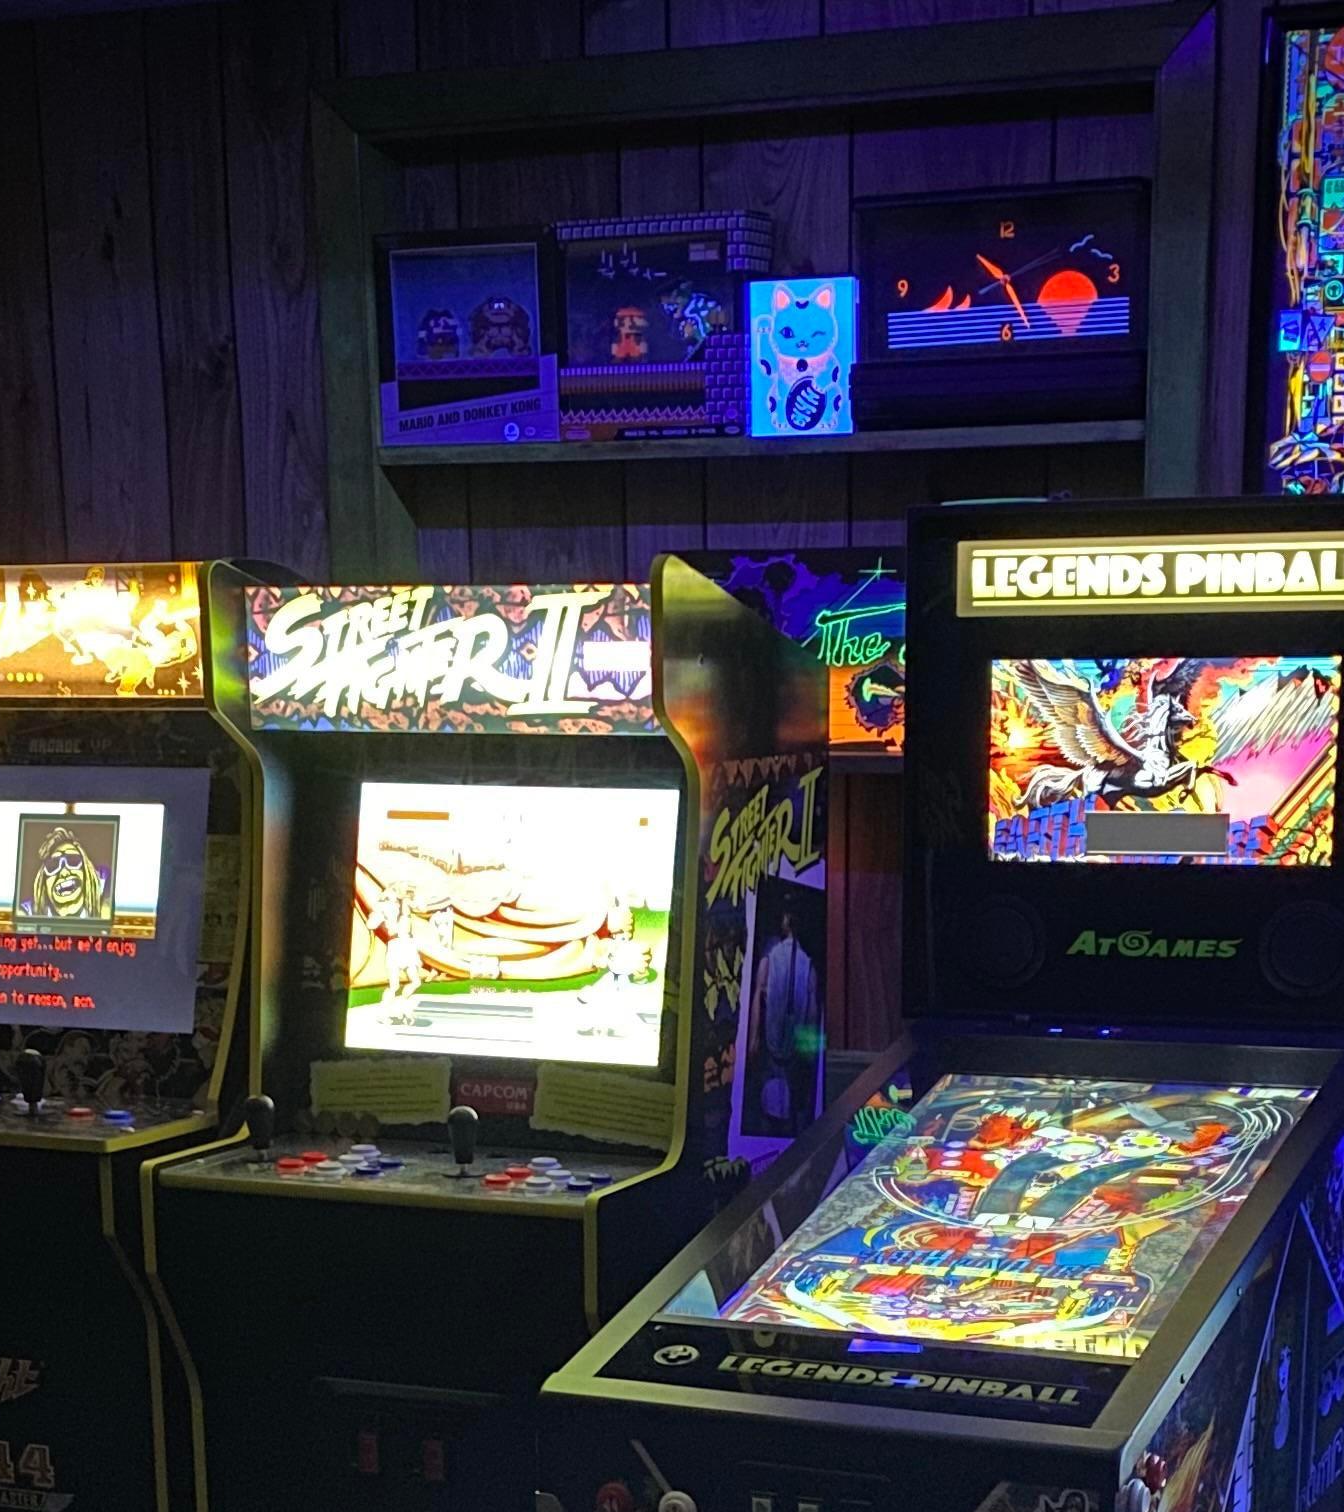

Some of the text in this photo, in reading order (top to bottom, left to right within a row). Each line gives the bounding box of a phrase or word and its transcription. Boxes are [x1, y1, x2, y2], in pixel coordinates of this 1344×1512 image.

[999, 221, 1016, 239] 12
[1107, 263, 1120, 282] 3
[897, 278, 909, 297] 9
[1000, 324, 1012, 341] 6
[399, 397, 542, 432] MARIO AND DONKEY KONG
[971, 552, 1167, 598] LEGENDS
[106, 937, 137, 957] enjoy
[11, 989, 25, 1006] to
[459, 1082, 531, 1100] CAPCOM
[717, 1354, 1081, 1407] LEGENDS PINBALL
